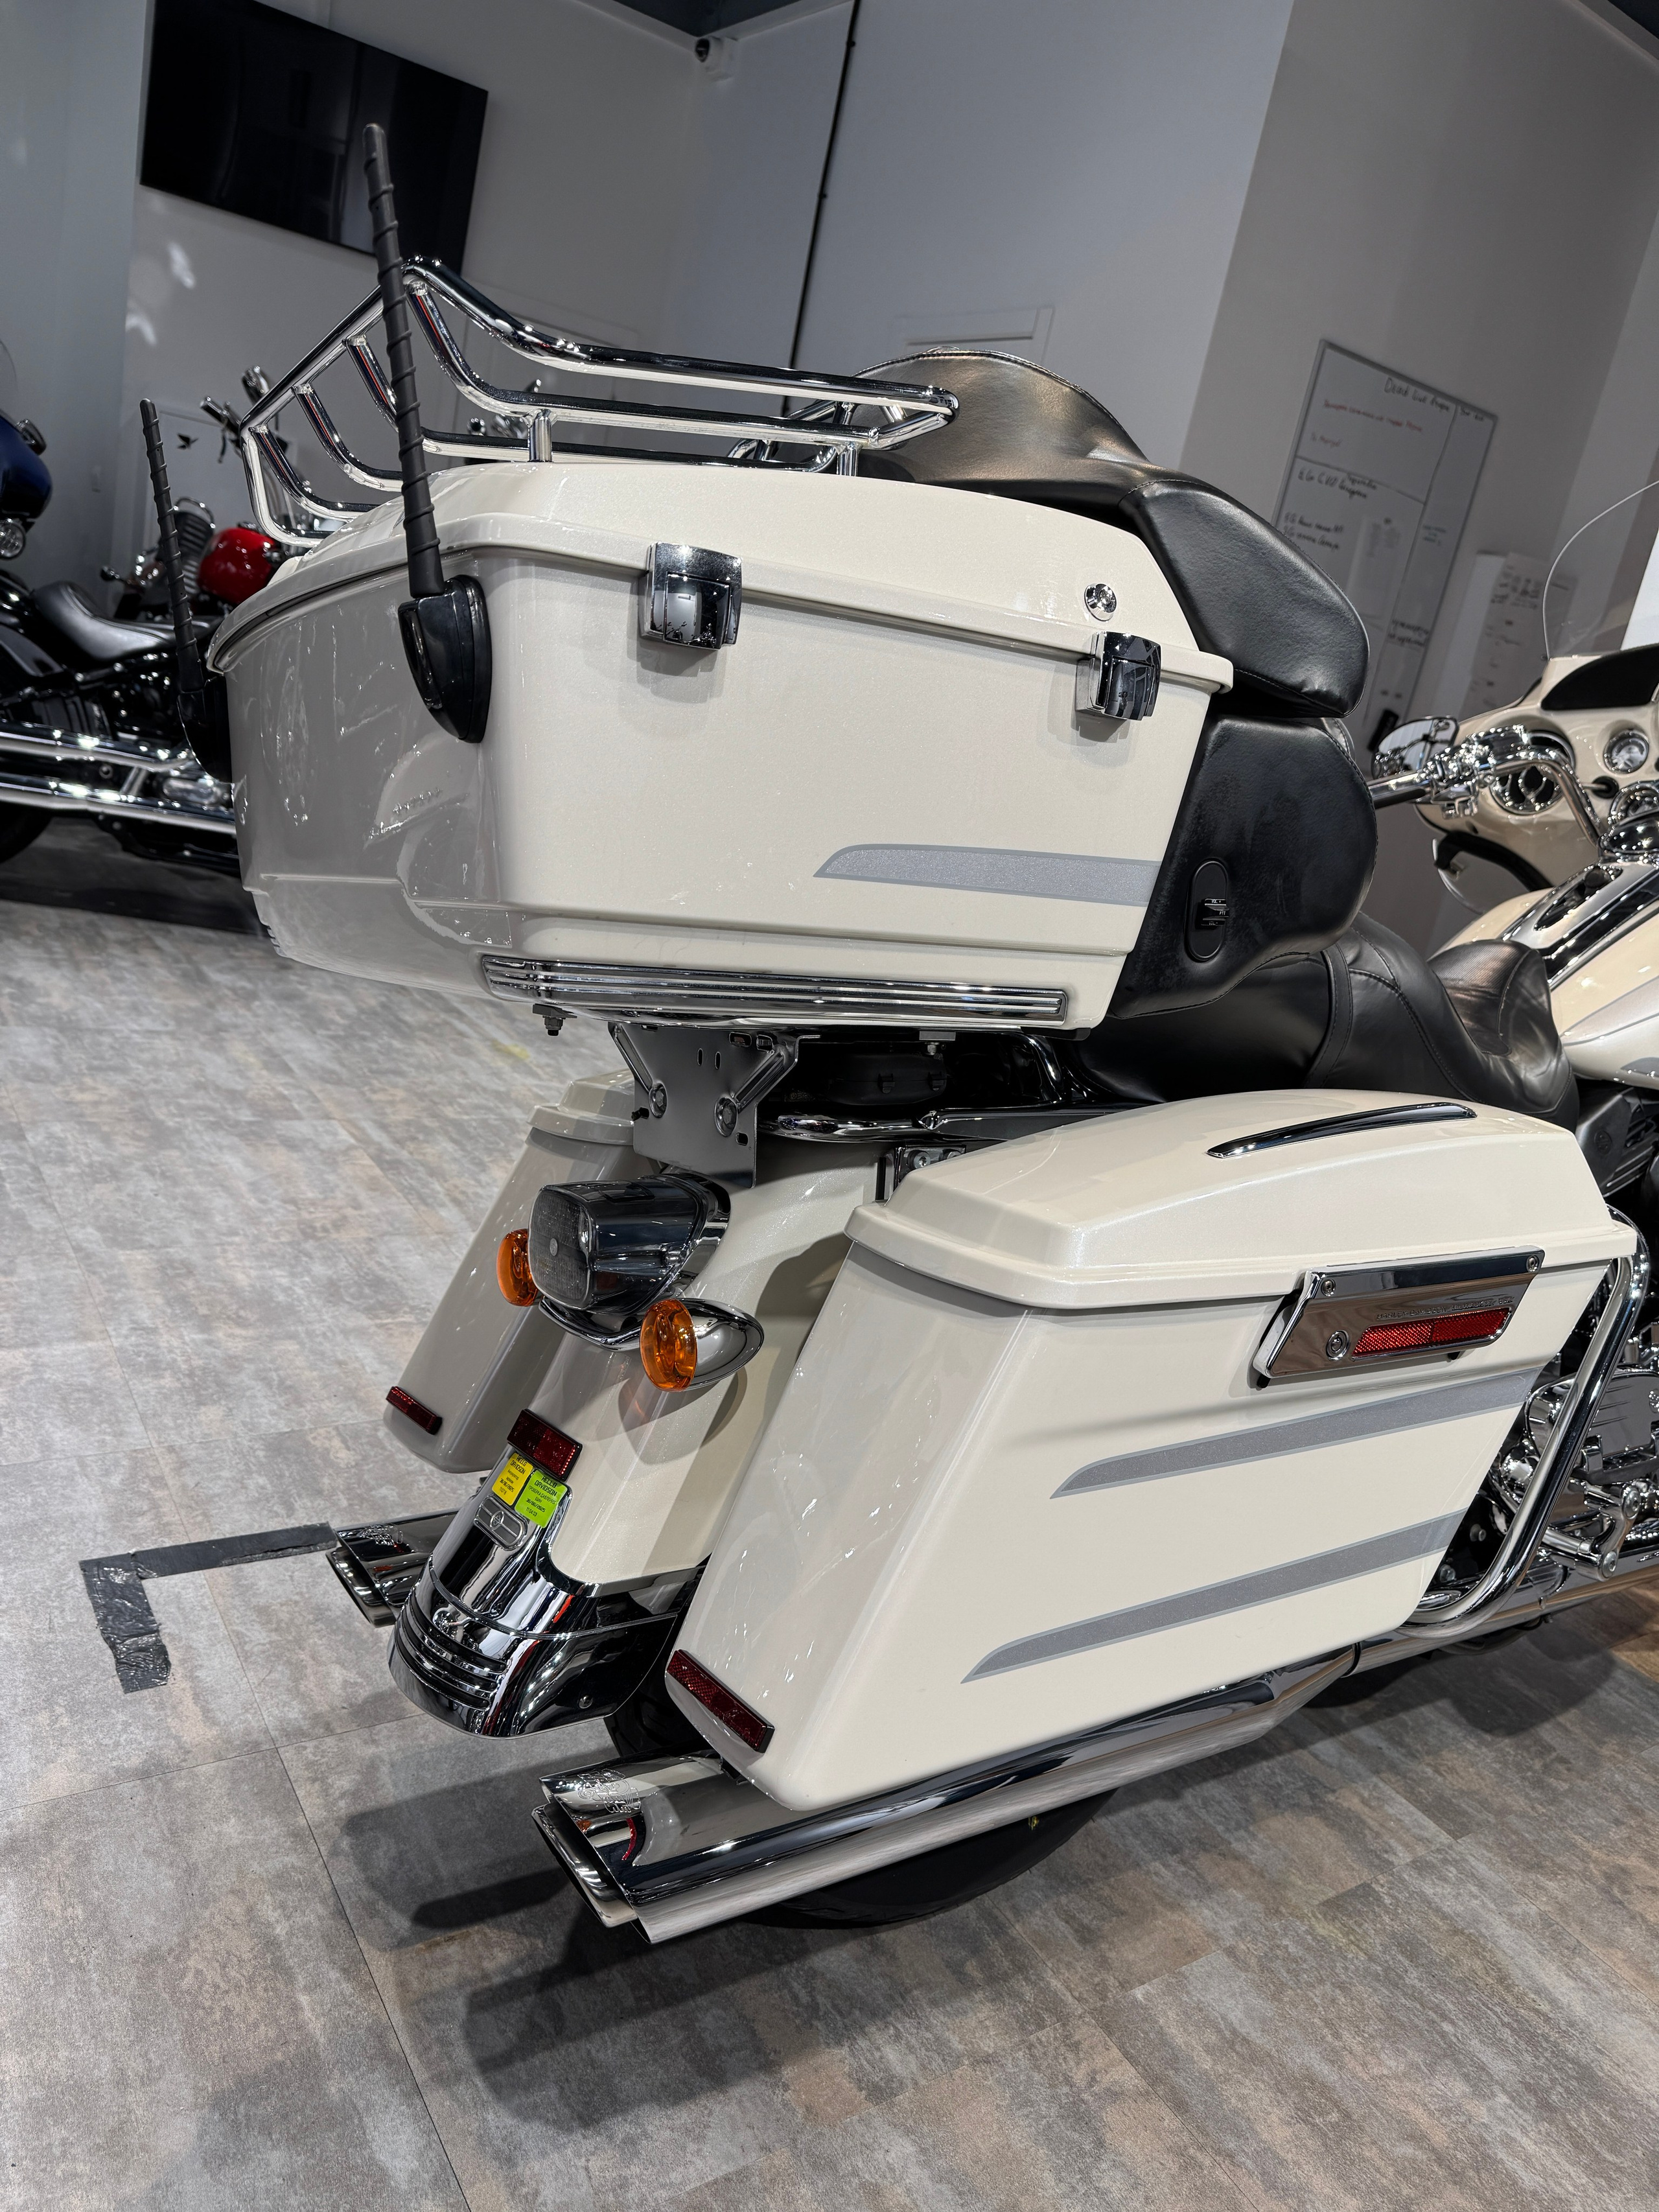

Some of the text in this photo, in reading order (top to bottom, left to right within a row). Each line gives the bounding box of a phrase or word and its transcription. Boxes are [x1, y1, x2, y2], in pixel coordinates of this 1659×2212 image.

[510, 1460, 526, 1474] DAVIDSON
[516, 1456, 528, 1467] HELLO
[534, 1480, 557, 1496] DAVIDSON
[541, 1475, 557, 1488] HELLO
